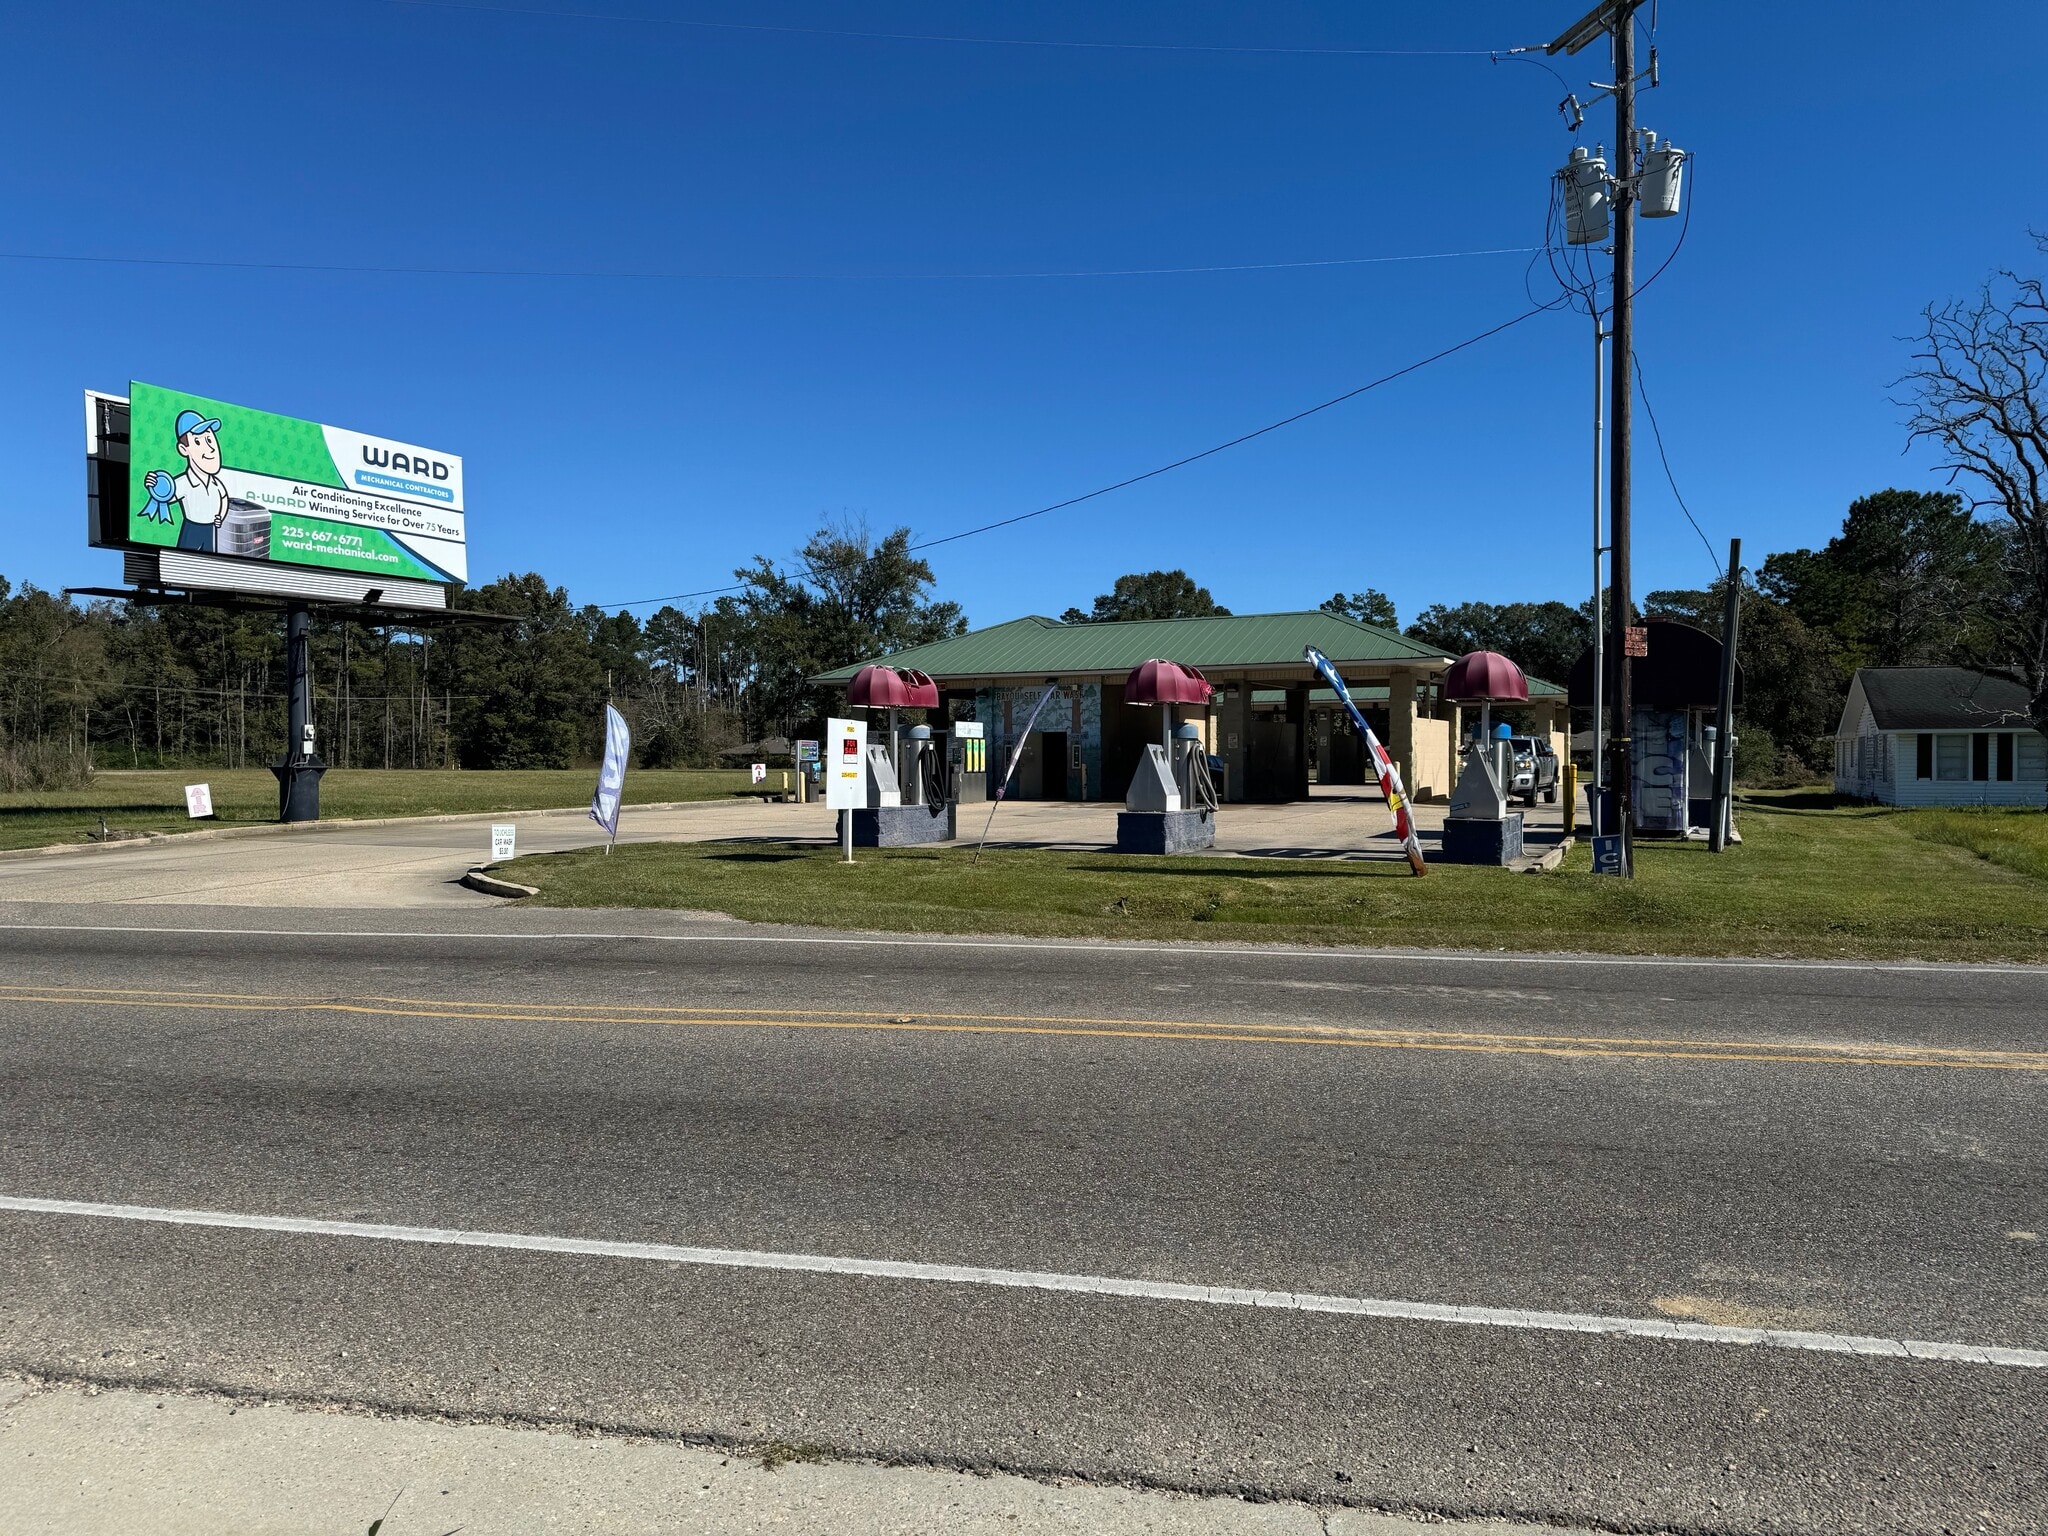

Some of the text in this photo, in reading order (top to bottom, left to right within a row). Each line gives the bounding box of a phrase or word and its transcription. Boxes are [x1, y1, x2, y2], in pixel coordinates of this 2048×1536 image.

[363, 445, 449, 481] WARD
[292, 486, 422, 517] Air Conditioning Excellence
[361, 474, 449, 498] MECHANICAL CONTRACTORS
[246, 491, 460, 536] A-WARD Winning Service for Over 75 Years
[282, 539, 399, 563] ward-mechanical.com
[996, 691, 1020, 701] BAYOU
[1599, 839, 1619, 875] ICE
